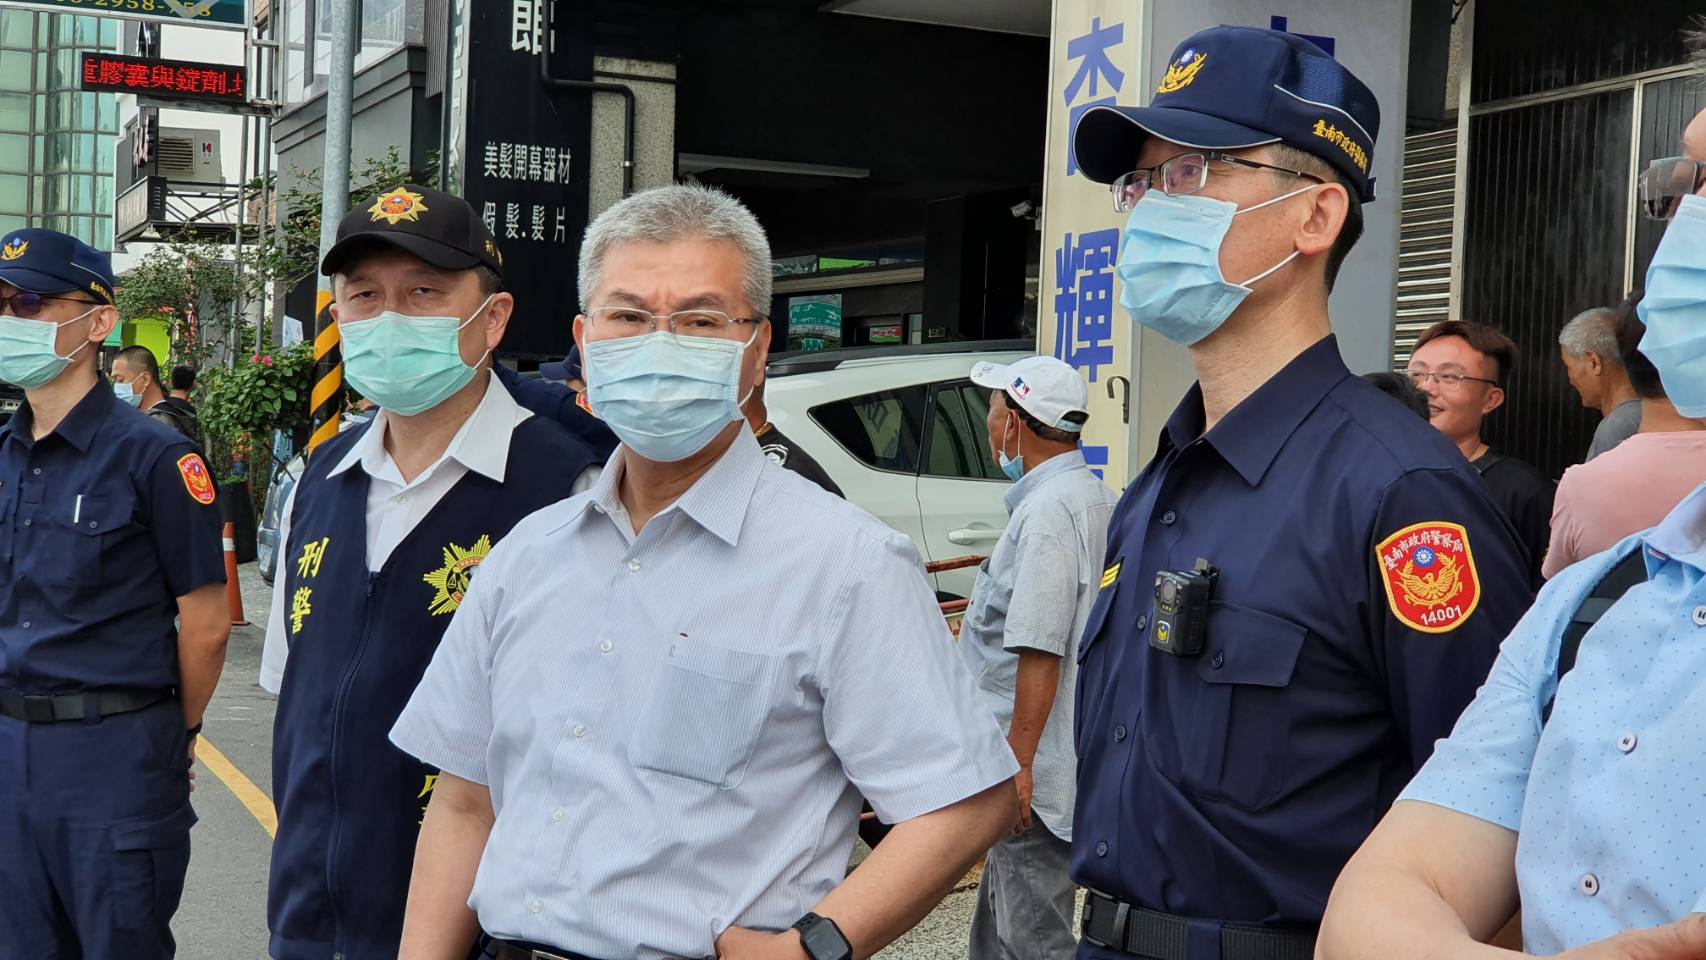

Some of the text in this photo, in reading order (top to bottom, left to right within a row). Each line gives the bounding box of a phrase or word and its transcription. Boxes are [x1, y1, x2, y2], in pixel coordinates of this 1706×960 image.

[484, 140, 571, 184] 美髮開幕器材
[1384, 530, 1463, 570] 臺南市政府警察局
[290, 537, 329, 634] 刑警
[1420, 605, 1463, 625] 14001
